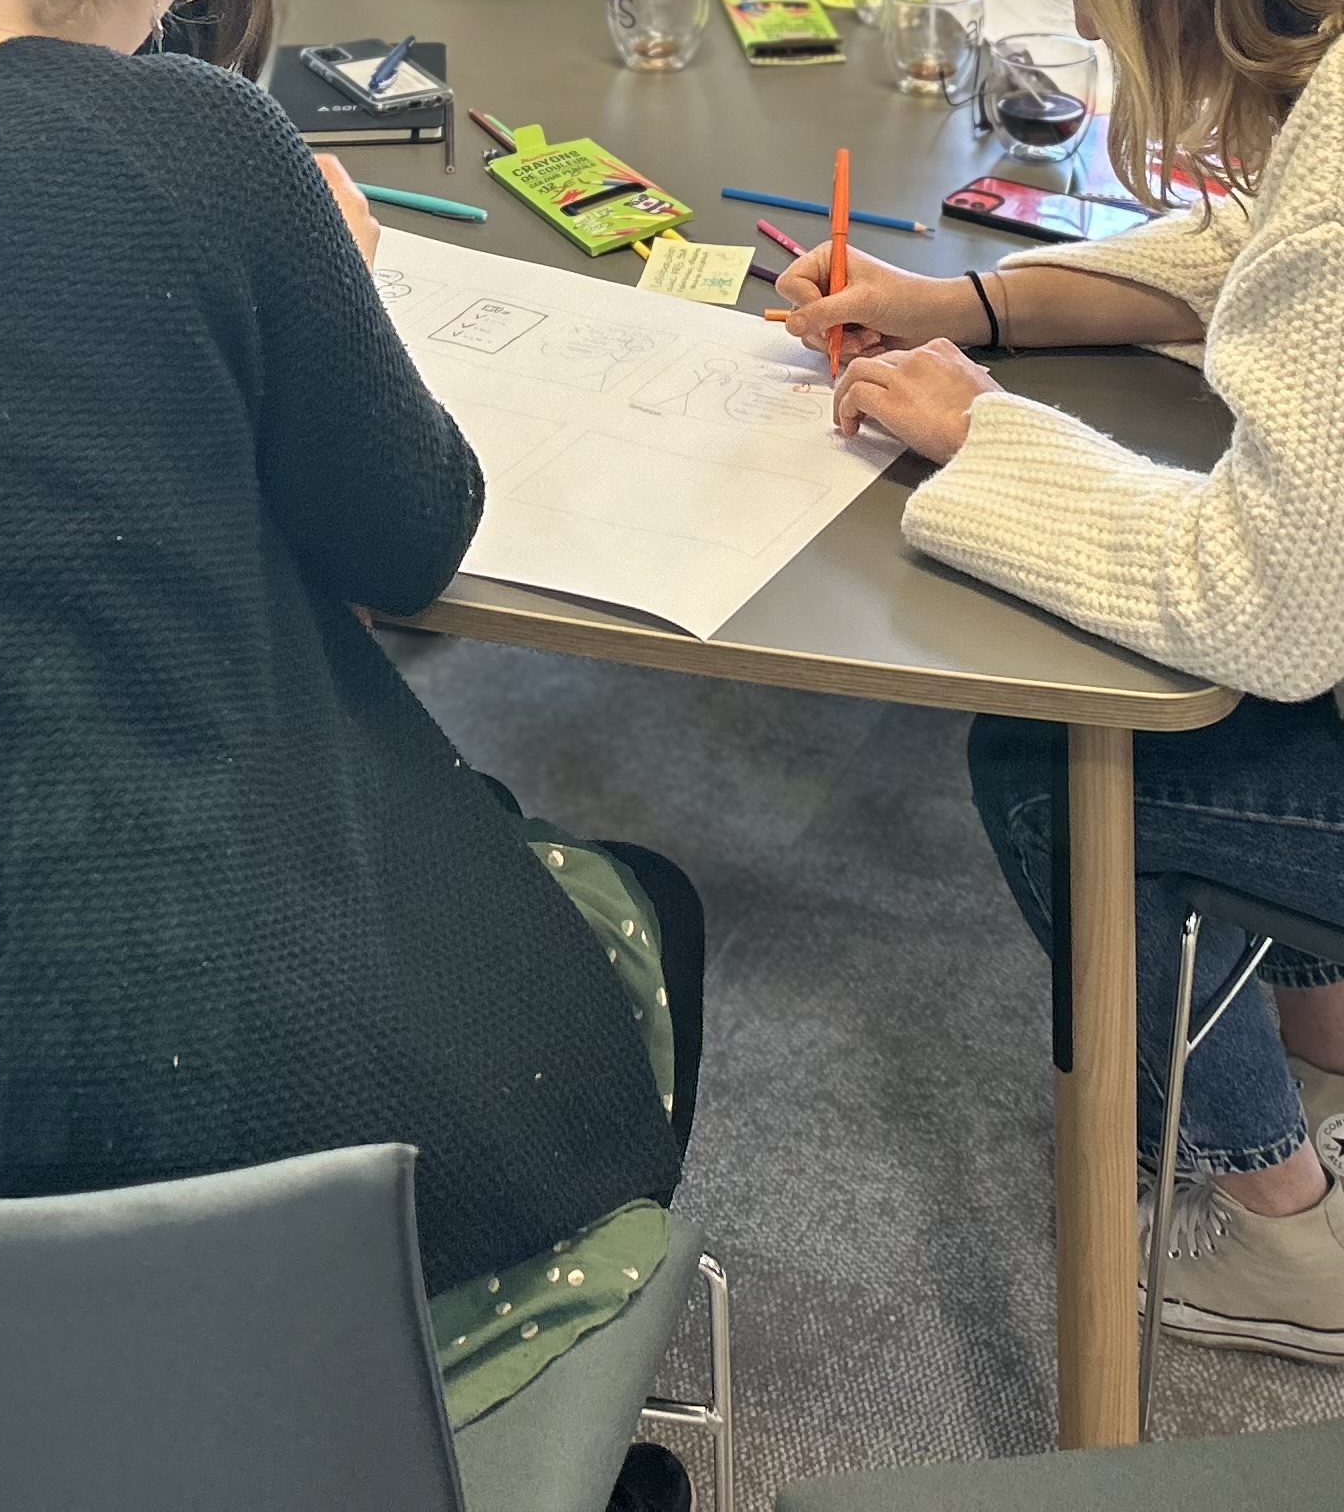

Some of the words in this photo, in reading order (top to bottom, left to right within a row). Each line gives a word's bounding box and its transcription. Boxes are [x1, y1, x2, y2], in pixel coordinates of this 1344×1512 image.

[512, 150, 581, 177] CRAYONS
[520, 172, 537, 183] DE
[537, 156, 589, 176] COULEUR
[1327, 1154, 1344, 1170] ALL
